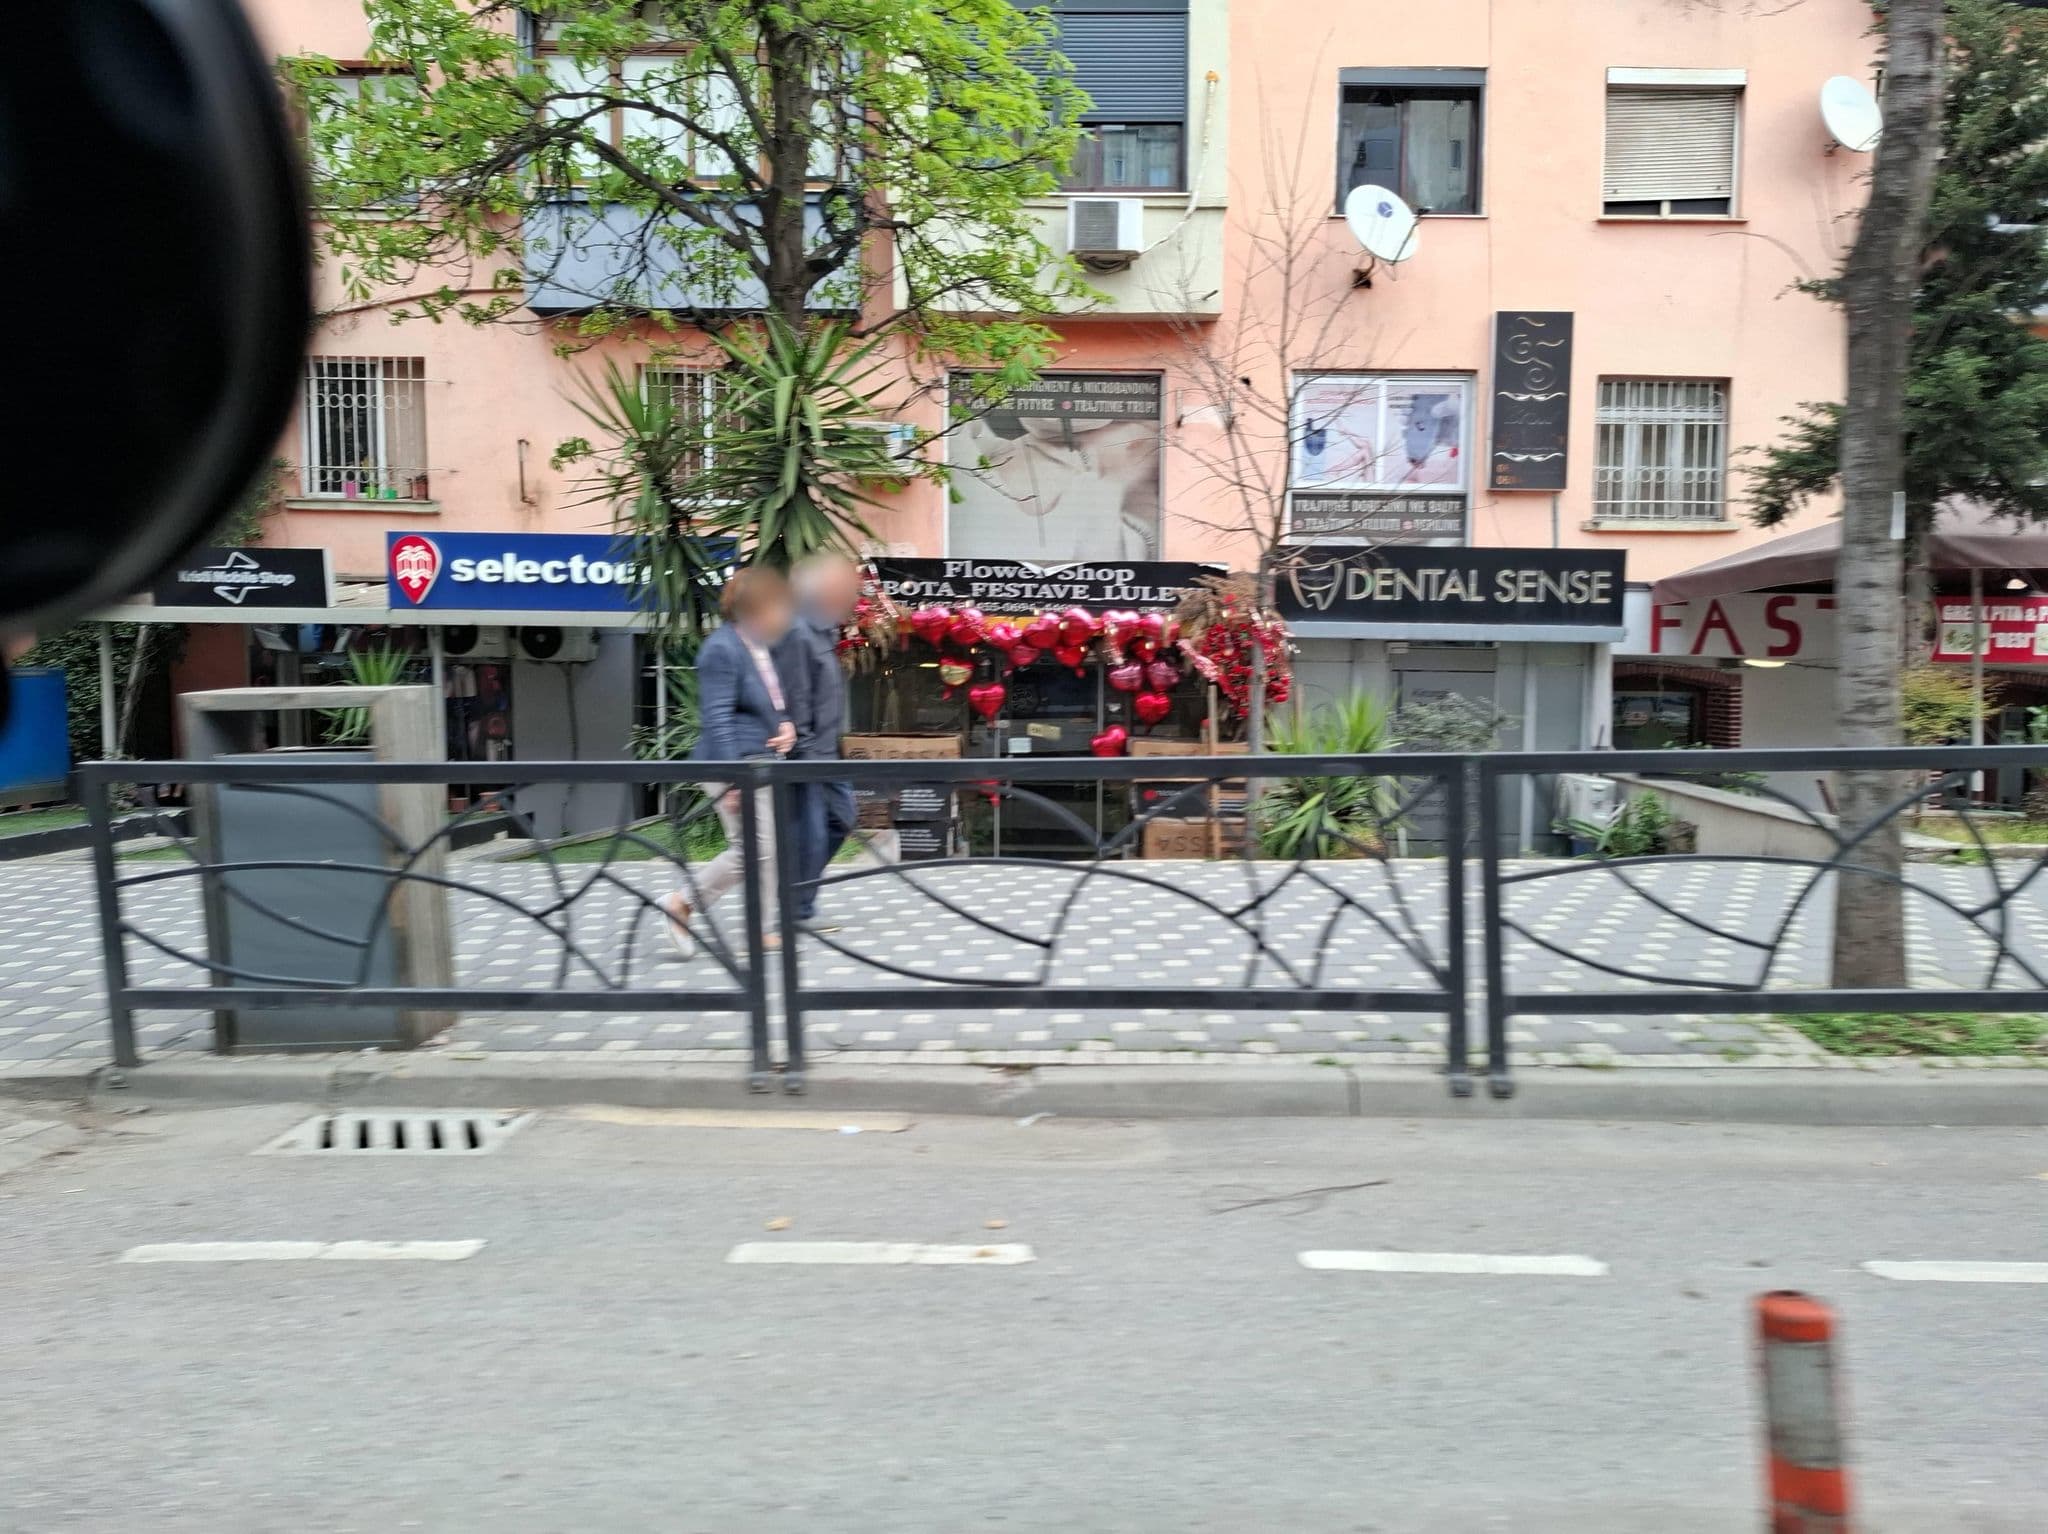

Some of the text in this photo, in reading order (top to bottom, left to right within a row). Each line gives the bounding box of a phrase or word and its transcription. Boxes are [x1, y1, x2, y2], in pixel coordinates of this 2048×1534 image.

[259, 572, 296, 587] Shop
[943, 560, 1136, 586] Flower Shop
[1345, 567, 1613, 605] DENTAL SENSE
[1650, 595, 1839, 657] FAS
